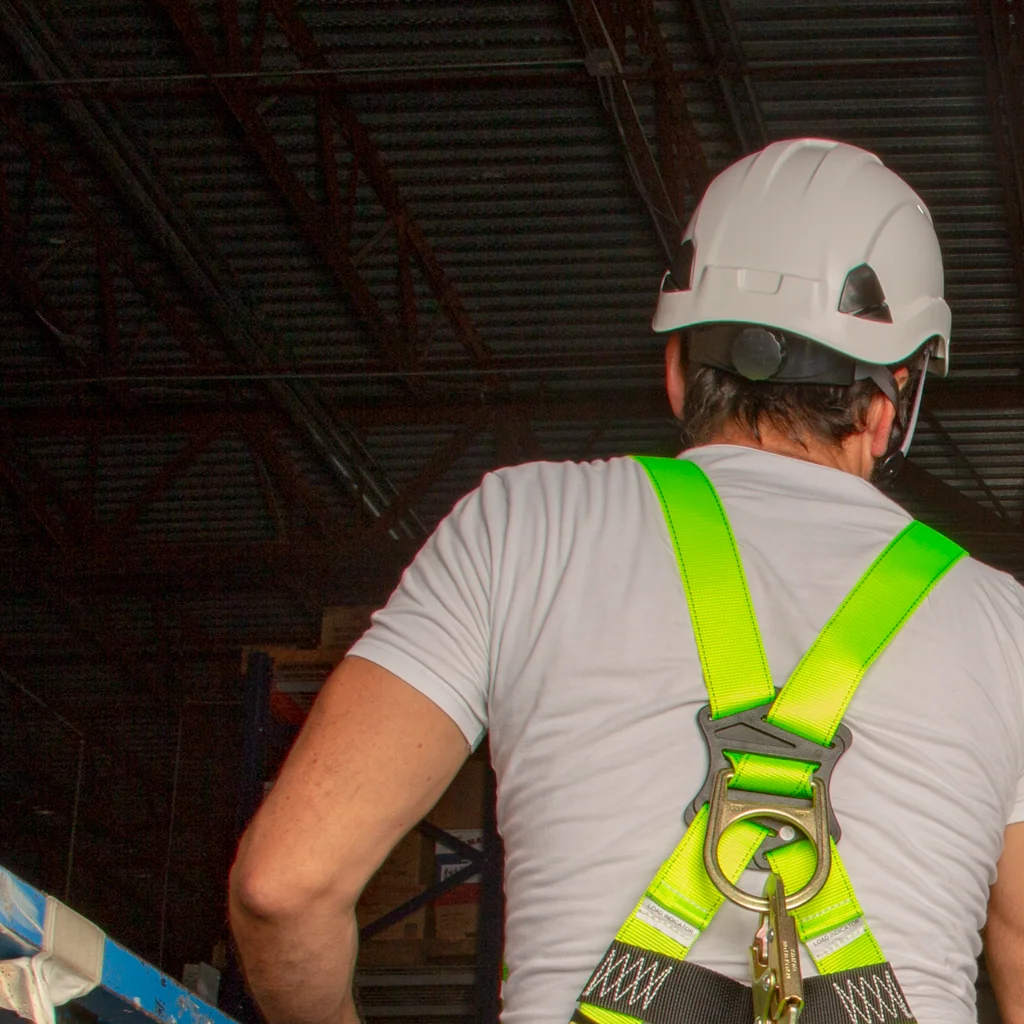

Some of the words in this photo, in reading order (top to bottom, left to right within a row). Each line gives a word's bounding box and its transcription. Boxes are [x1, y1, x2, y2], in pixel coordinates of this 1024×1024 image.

[647, 903, 664, 916] LOAD
[664, 913, 694, 935] INDICATOR
[812, 934, 830, 947] LOAD
[830, 919, 860, 938] INDICATOR
